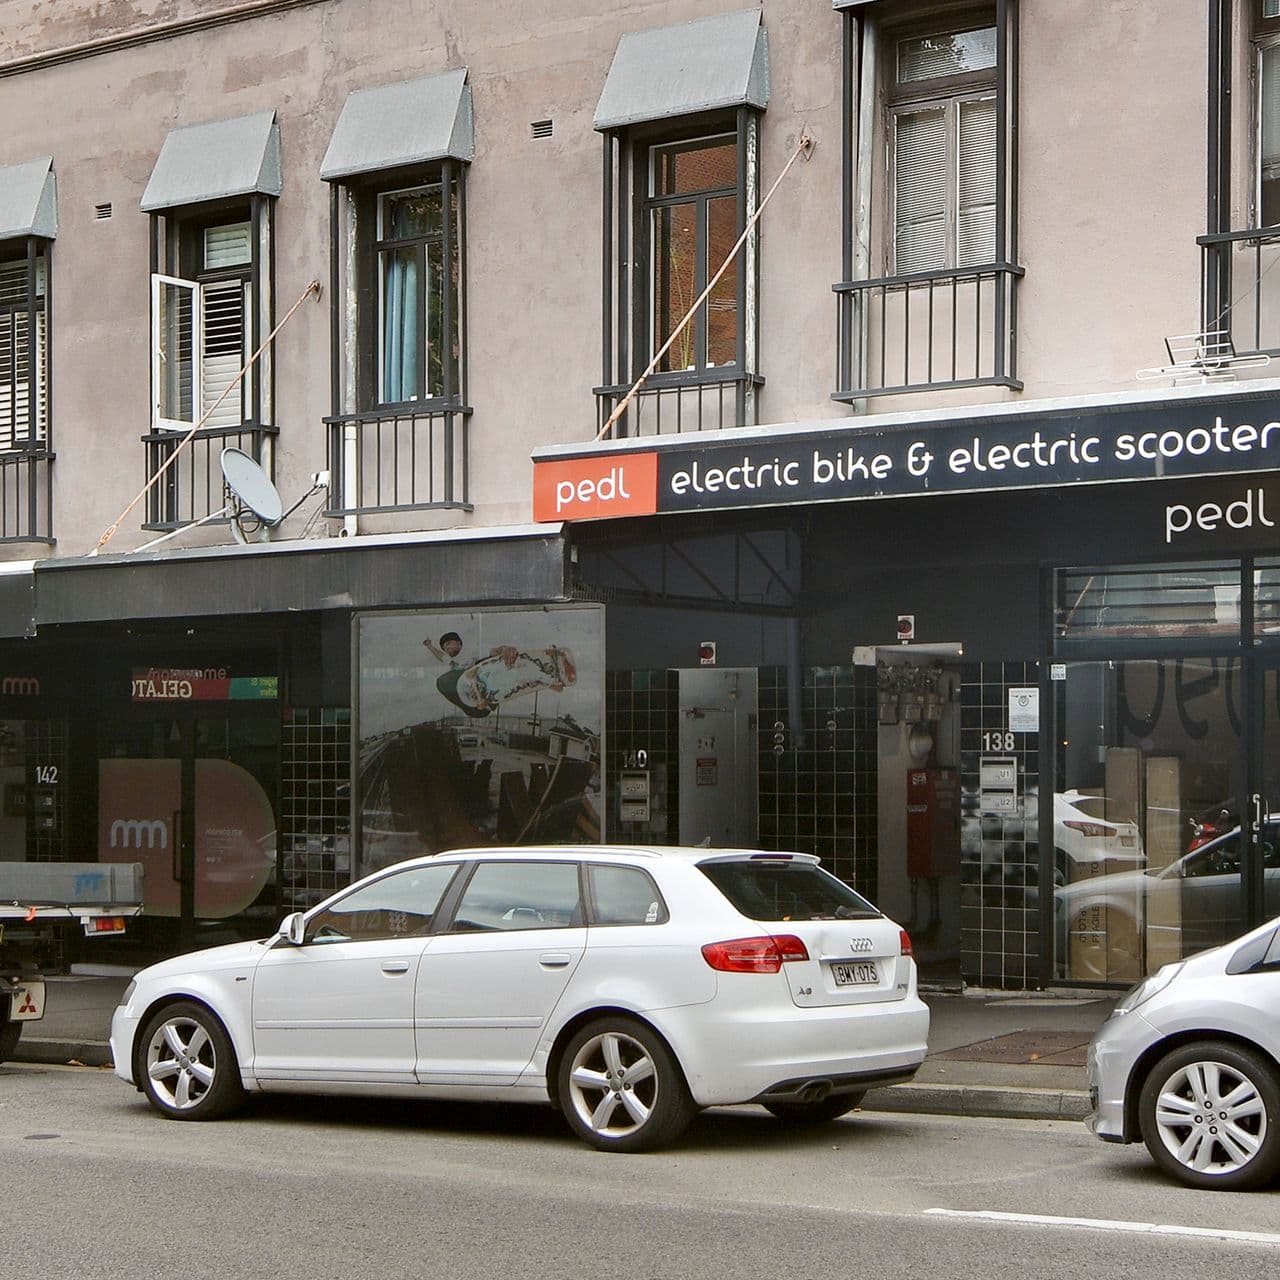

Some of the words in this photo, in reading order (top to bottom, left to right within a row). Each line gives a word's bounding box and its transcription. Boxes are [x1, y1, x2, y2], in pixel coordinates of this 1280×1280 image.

[670, 455, 800, 495] electric
[813, 447, 893, 484] bike
[907, 442, 934, 476] &
[948, 431, 1101, 473] electric
[556, 467, 631, 512] pedl
[1165, 488, 1275, 543] pedl
[983, 732, 1015, 752] 138
[35, 765, 59, 784] 142
